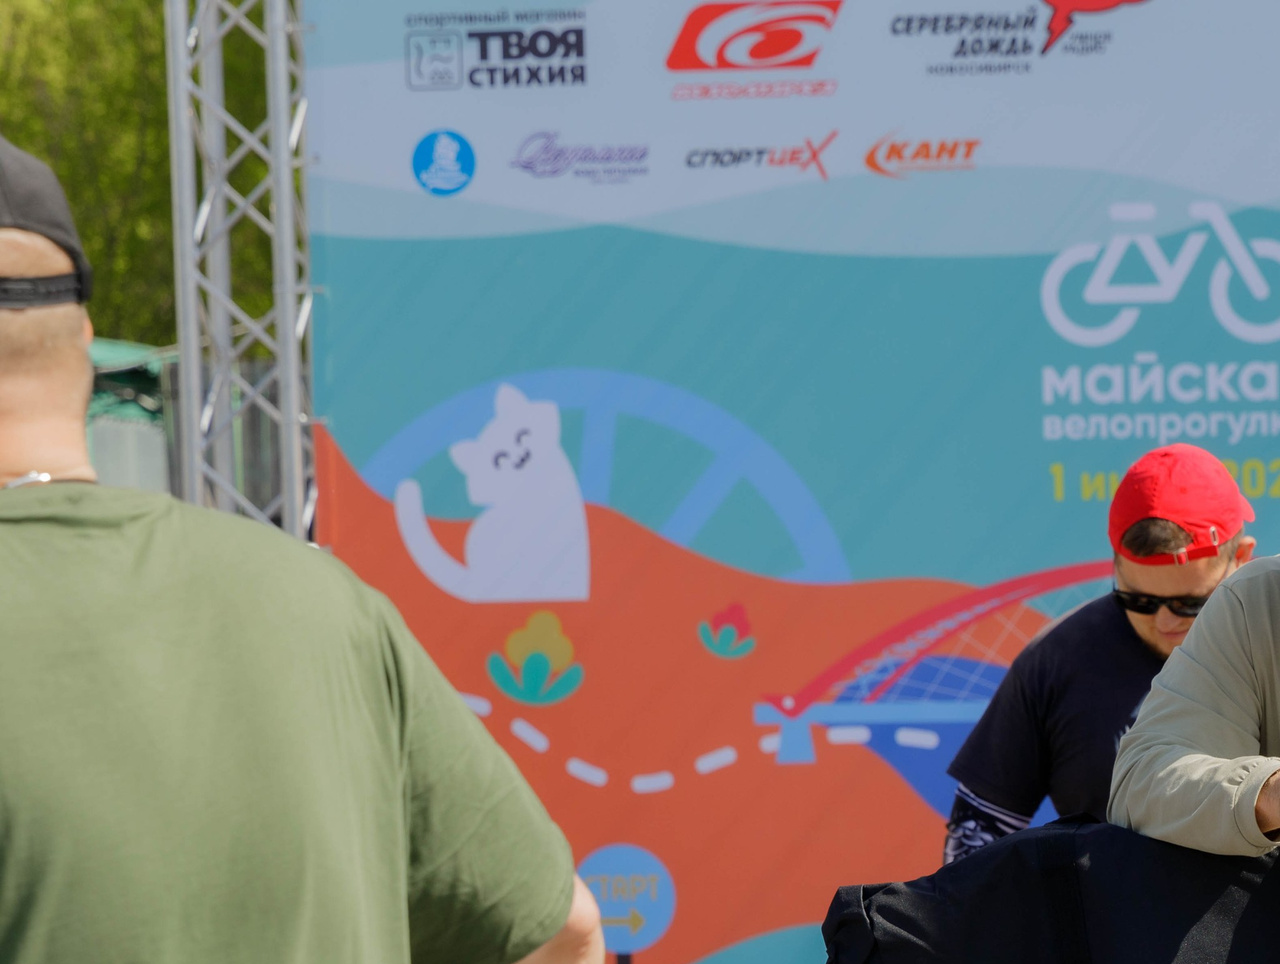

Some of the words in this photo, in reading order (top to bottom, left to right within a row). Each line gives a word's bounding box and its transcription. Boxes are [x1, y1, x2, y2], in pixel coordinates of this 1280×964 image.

[890, 6, 1038, 36] СЕРЕБРЯНЫЙ
[467, 28, 586, 62] ТВОЯ
[953, 36, 1034, 58] ДОЖДЬ
[468, 64, 586, 88] СТИХИЯ
[884, 138, 982, 163] КАНТ
